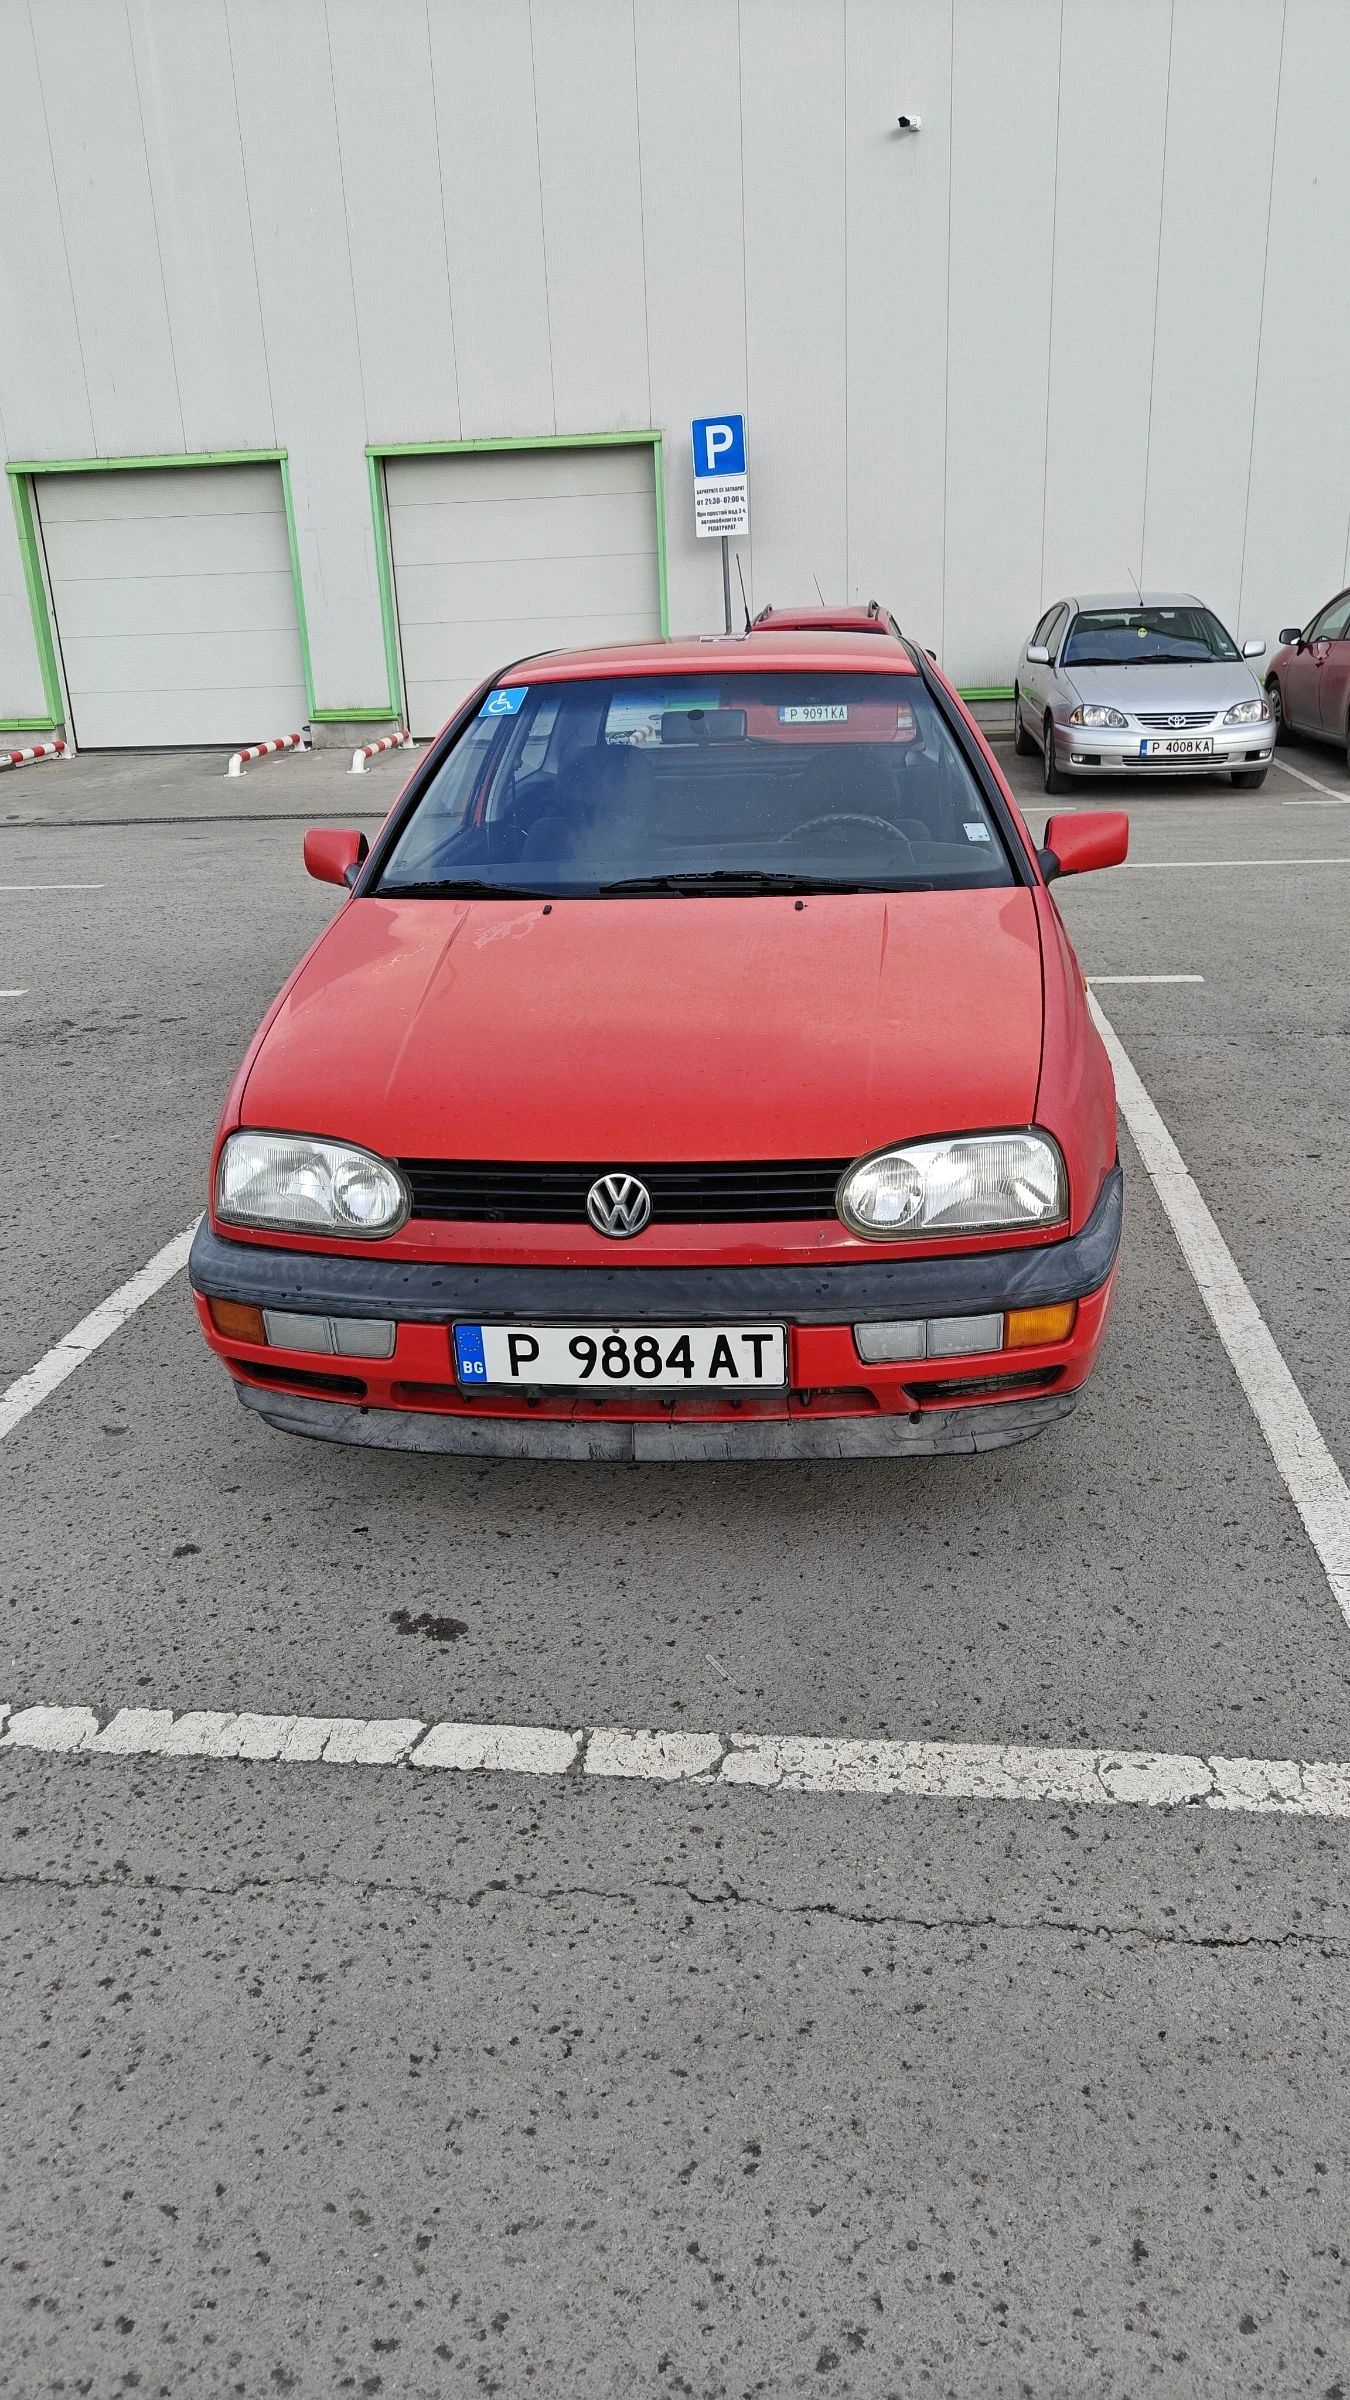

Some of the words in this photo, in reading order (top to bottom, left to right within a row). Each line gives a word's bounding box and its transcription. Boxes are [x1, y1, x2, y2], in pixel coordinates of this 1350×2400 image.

[706, 425, 734, 470] P
[790, 708, 798, 720] P
[1152, 742, 1160, 754] P
[507, 1333, 540, 1377] P
[568, 1334, 695, 1379] 9884
[708, 1333, 774, 1379] AT
[462, 1360, 484, 1374] BG
